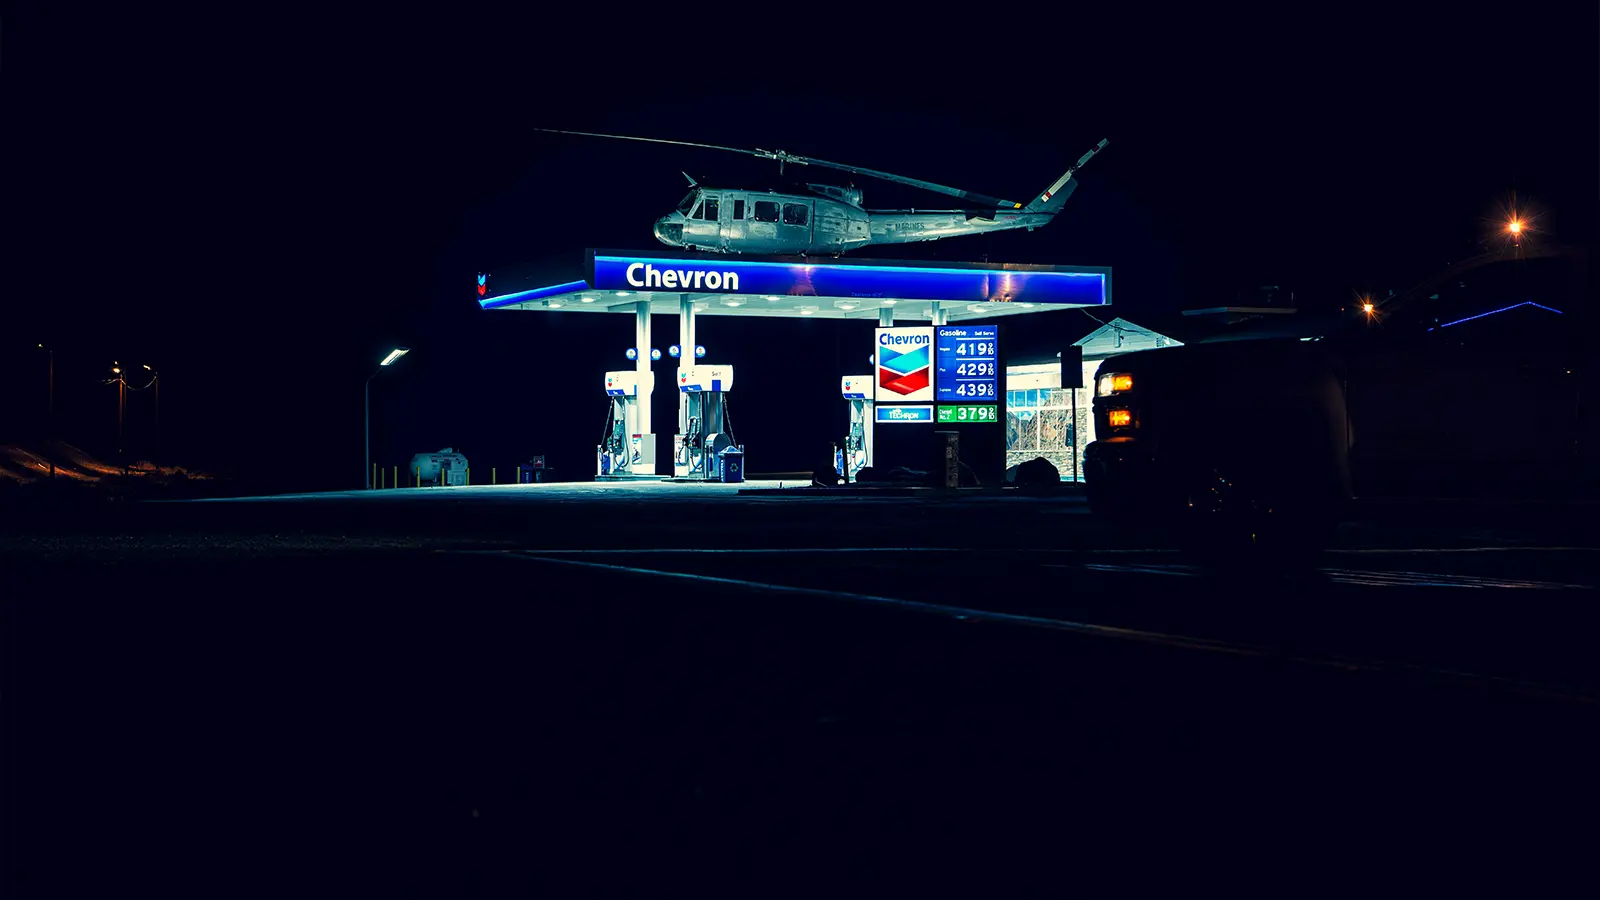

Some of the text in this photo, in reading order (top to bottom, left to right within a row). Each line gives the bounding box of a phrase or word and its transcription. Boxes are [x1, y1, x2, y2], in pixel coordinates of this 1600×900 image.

[895, 222, 924, 231] MARINES
[626, 262, 739, 290] Chevron
[880, 333, 930, 345] Chevron
[956, 343, 987, 355] 419
[956, 363, 987, 375] 429
[956, 384, 986, 396] 439
[889, 411, 919, 420] TECHRON
[958, 408, 988, 420] 379
